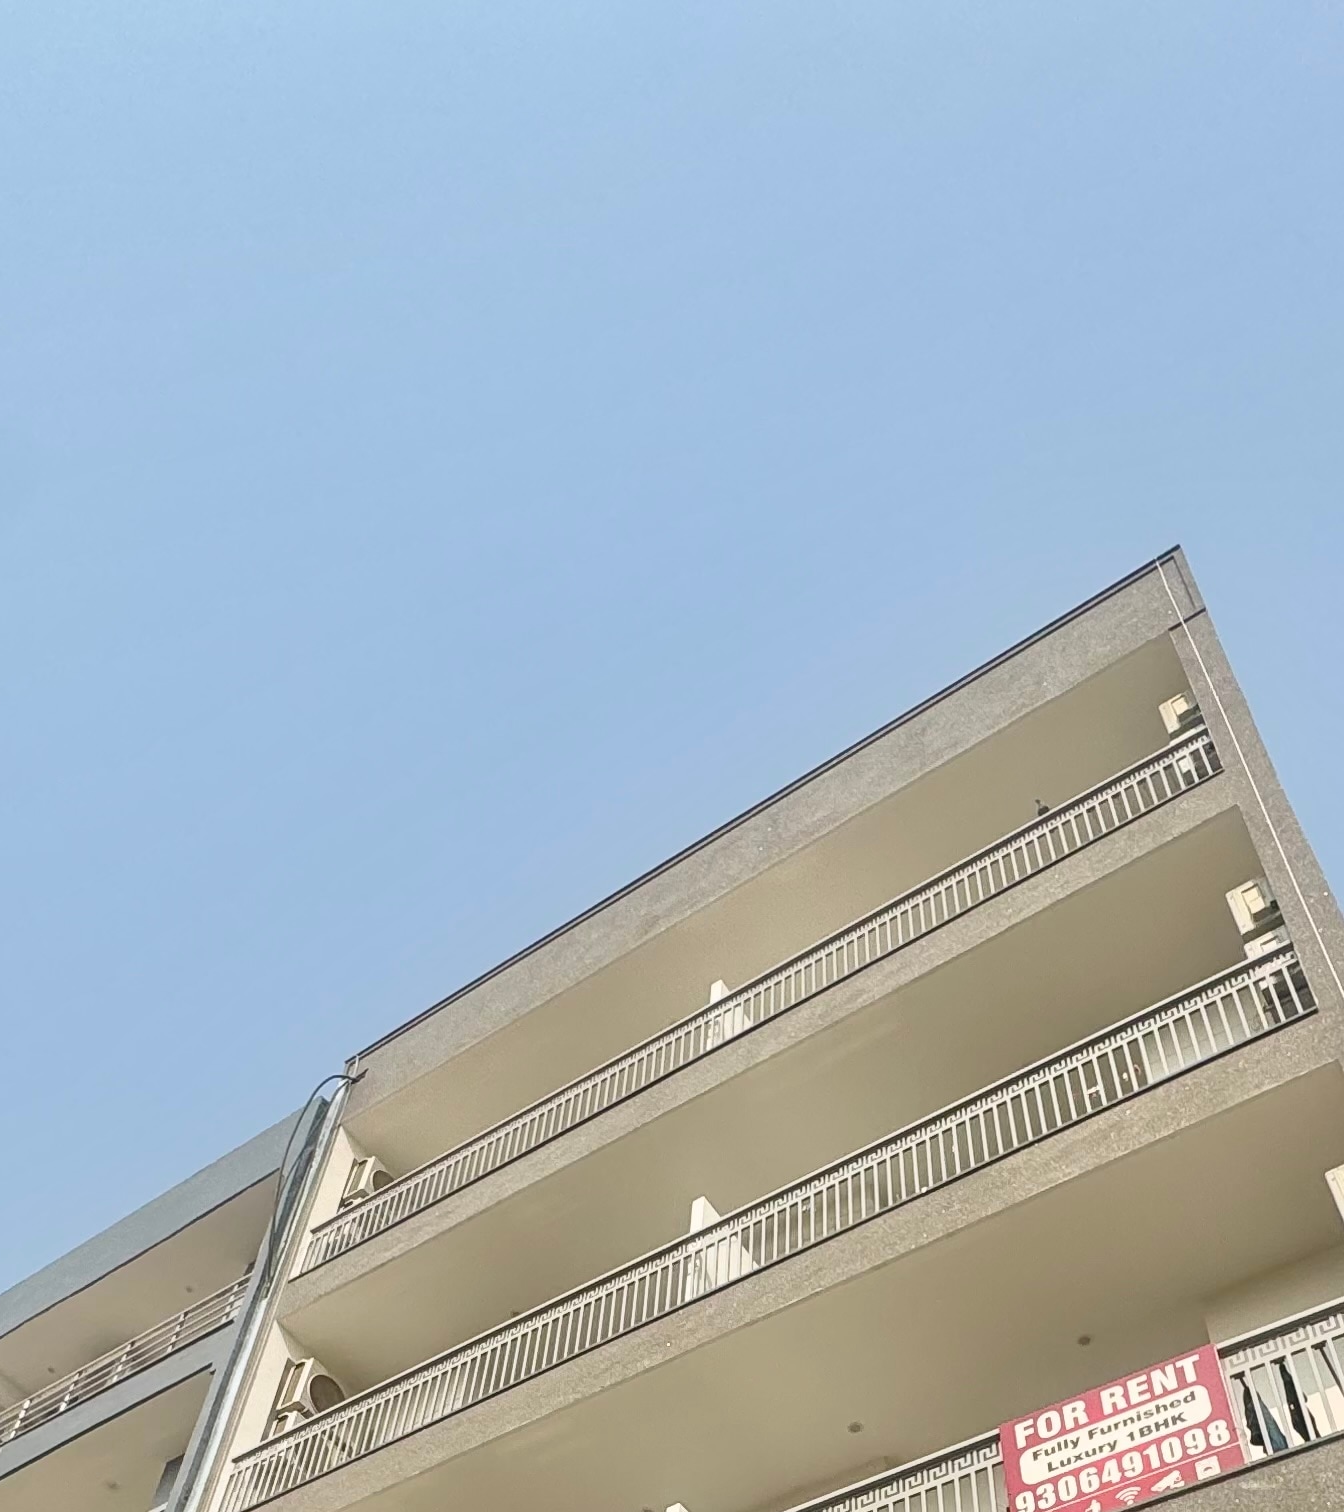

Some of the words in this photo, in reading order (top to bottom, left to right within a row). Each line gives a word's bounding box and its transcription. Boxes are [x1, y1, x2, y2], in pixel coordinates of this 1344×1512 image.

[1013, 1400, 1090, 1450] FOR
[1100, 1354, 1200, 1416] RENT
[1032, 1434, 1081, 1462] Fully
[1088, 1390, 1197, 1440] Furnished
[1047, 1439, 1118, 1473] Luxury
[1127, 1411, 1188, 1442] 1BHK
